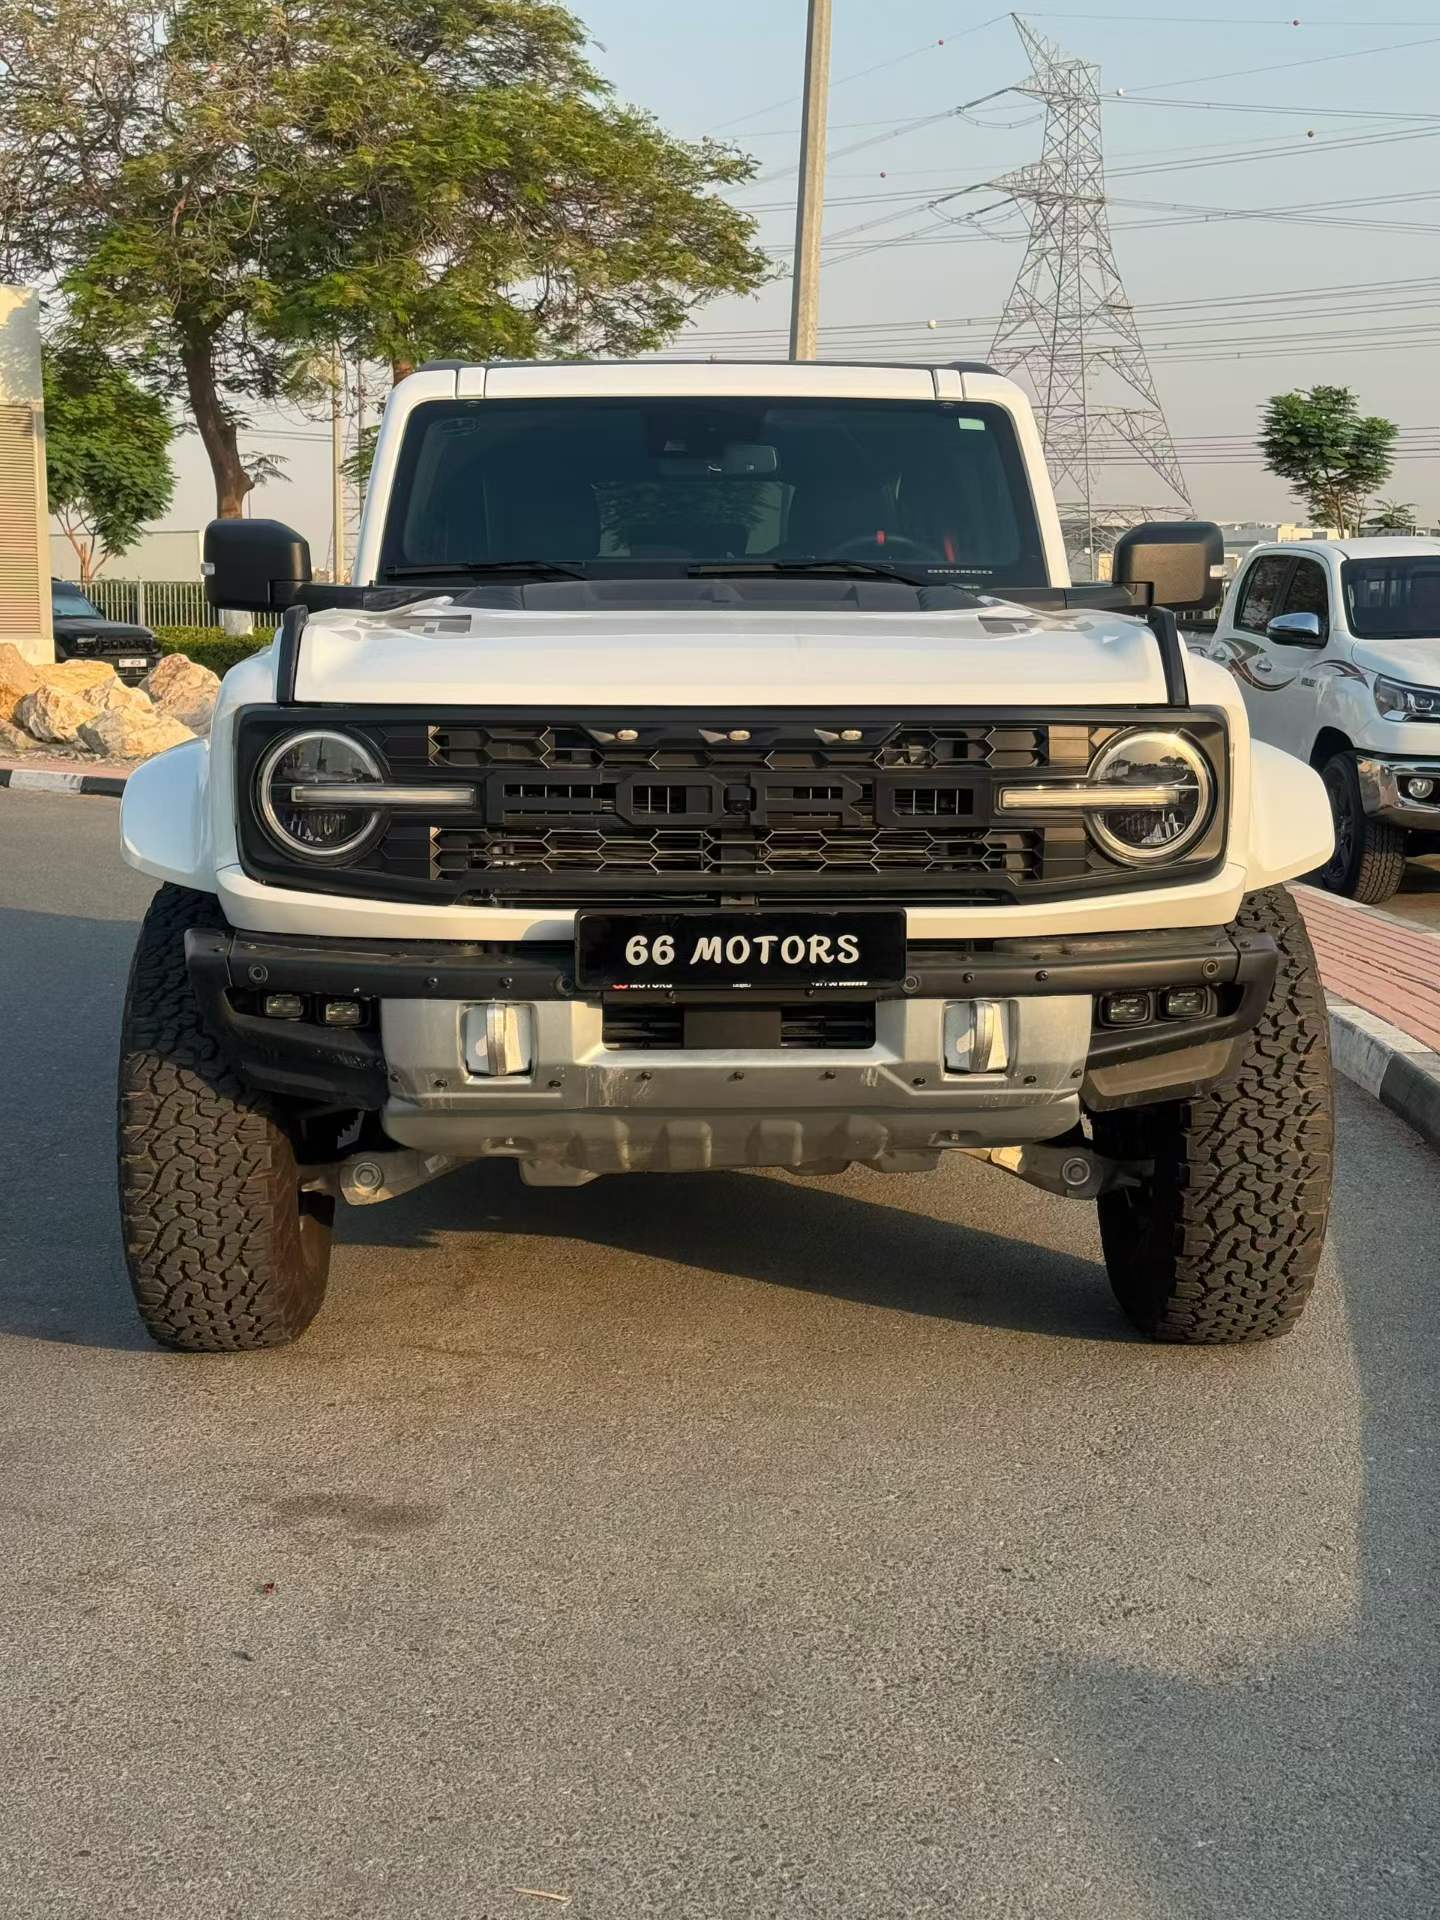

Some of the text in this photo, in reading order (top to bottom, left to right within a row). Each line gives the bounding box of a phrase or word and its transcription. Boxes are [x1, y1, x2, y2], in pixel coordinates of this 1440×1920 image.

[486, 772, 990, 826] FORD
[625, 934, 860, 965] 66 MOTORS
